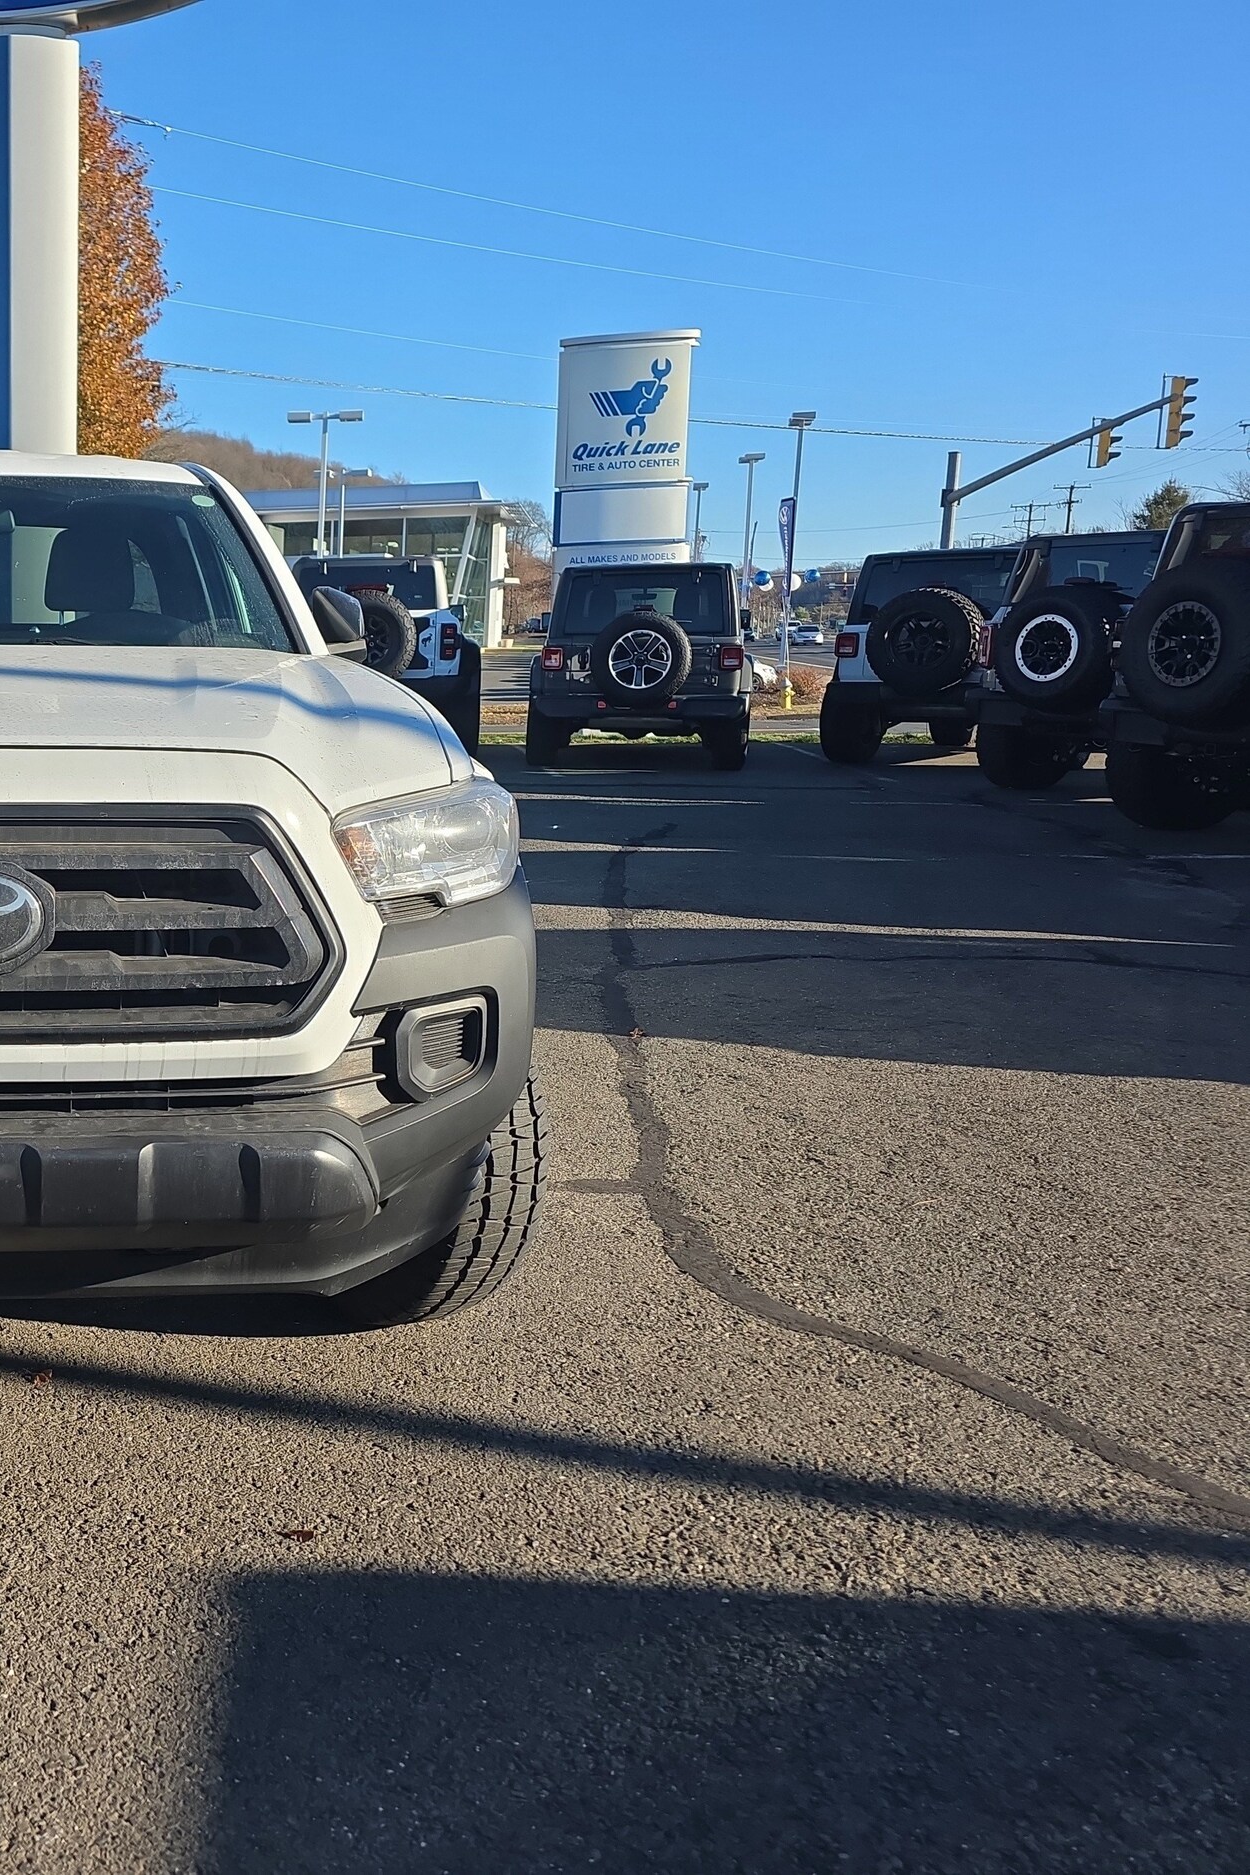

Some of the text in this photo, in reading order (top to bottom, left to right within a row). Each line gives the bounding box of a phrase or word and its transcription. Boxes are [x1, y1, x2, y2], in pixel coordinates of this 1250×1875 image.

[572, 440, 680, 460] Quick Lane
[572, 459, 680, 472] TIRE & AUTO CENTER
[587, 555, 618, 563] MAKES
[620, 554, 639, 562] AND
[641, 552, 676, 561] MODELS
